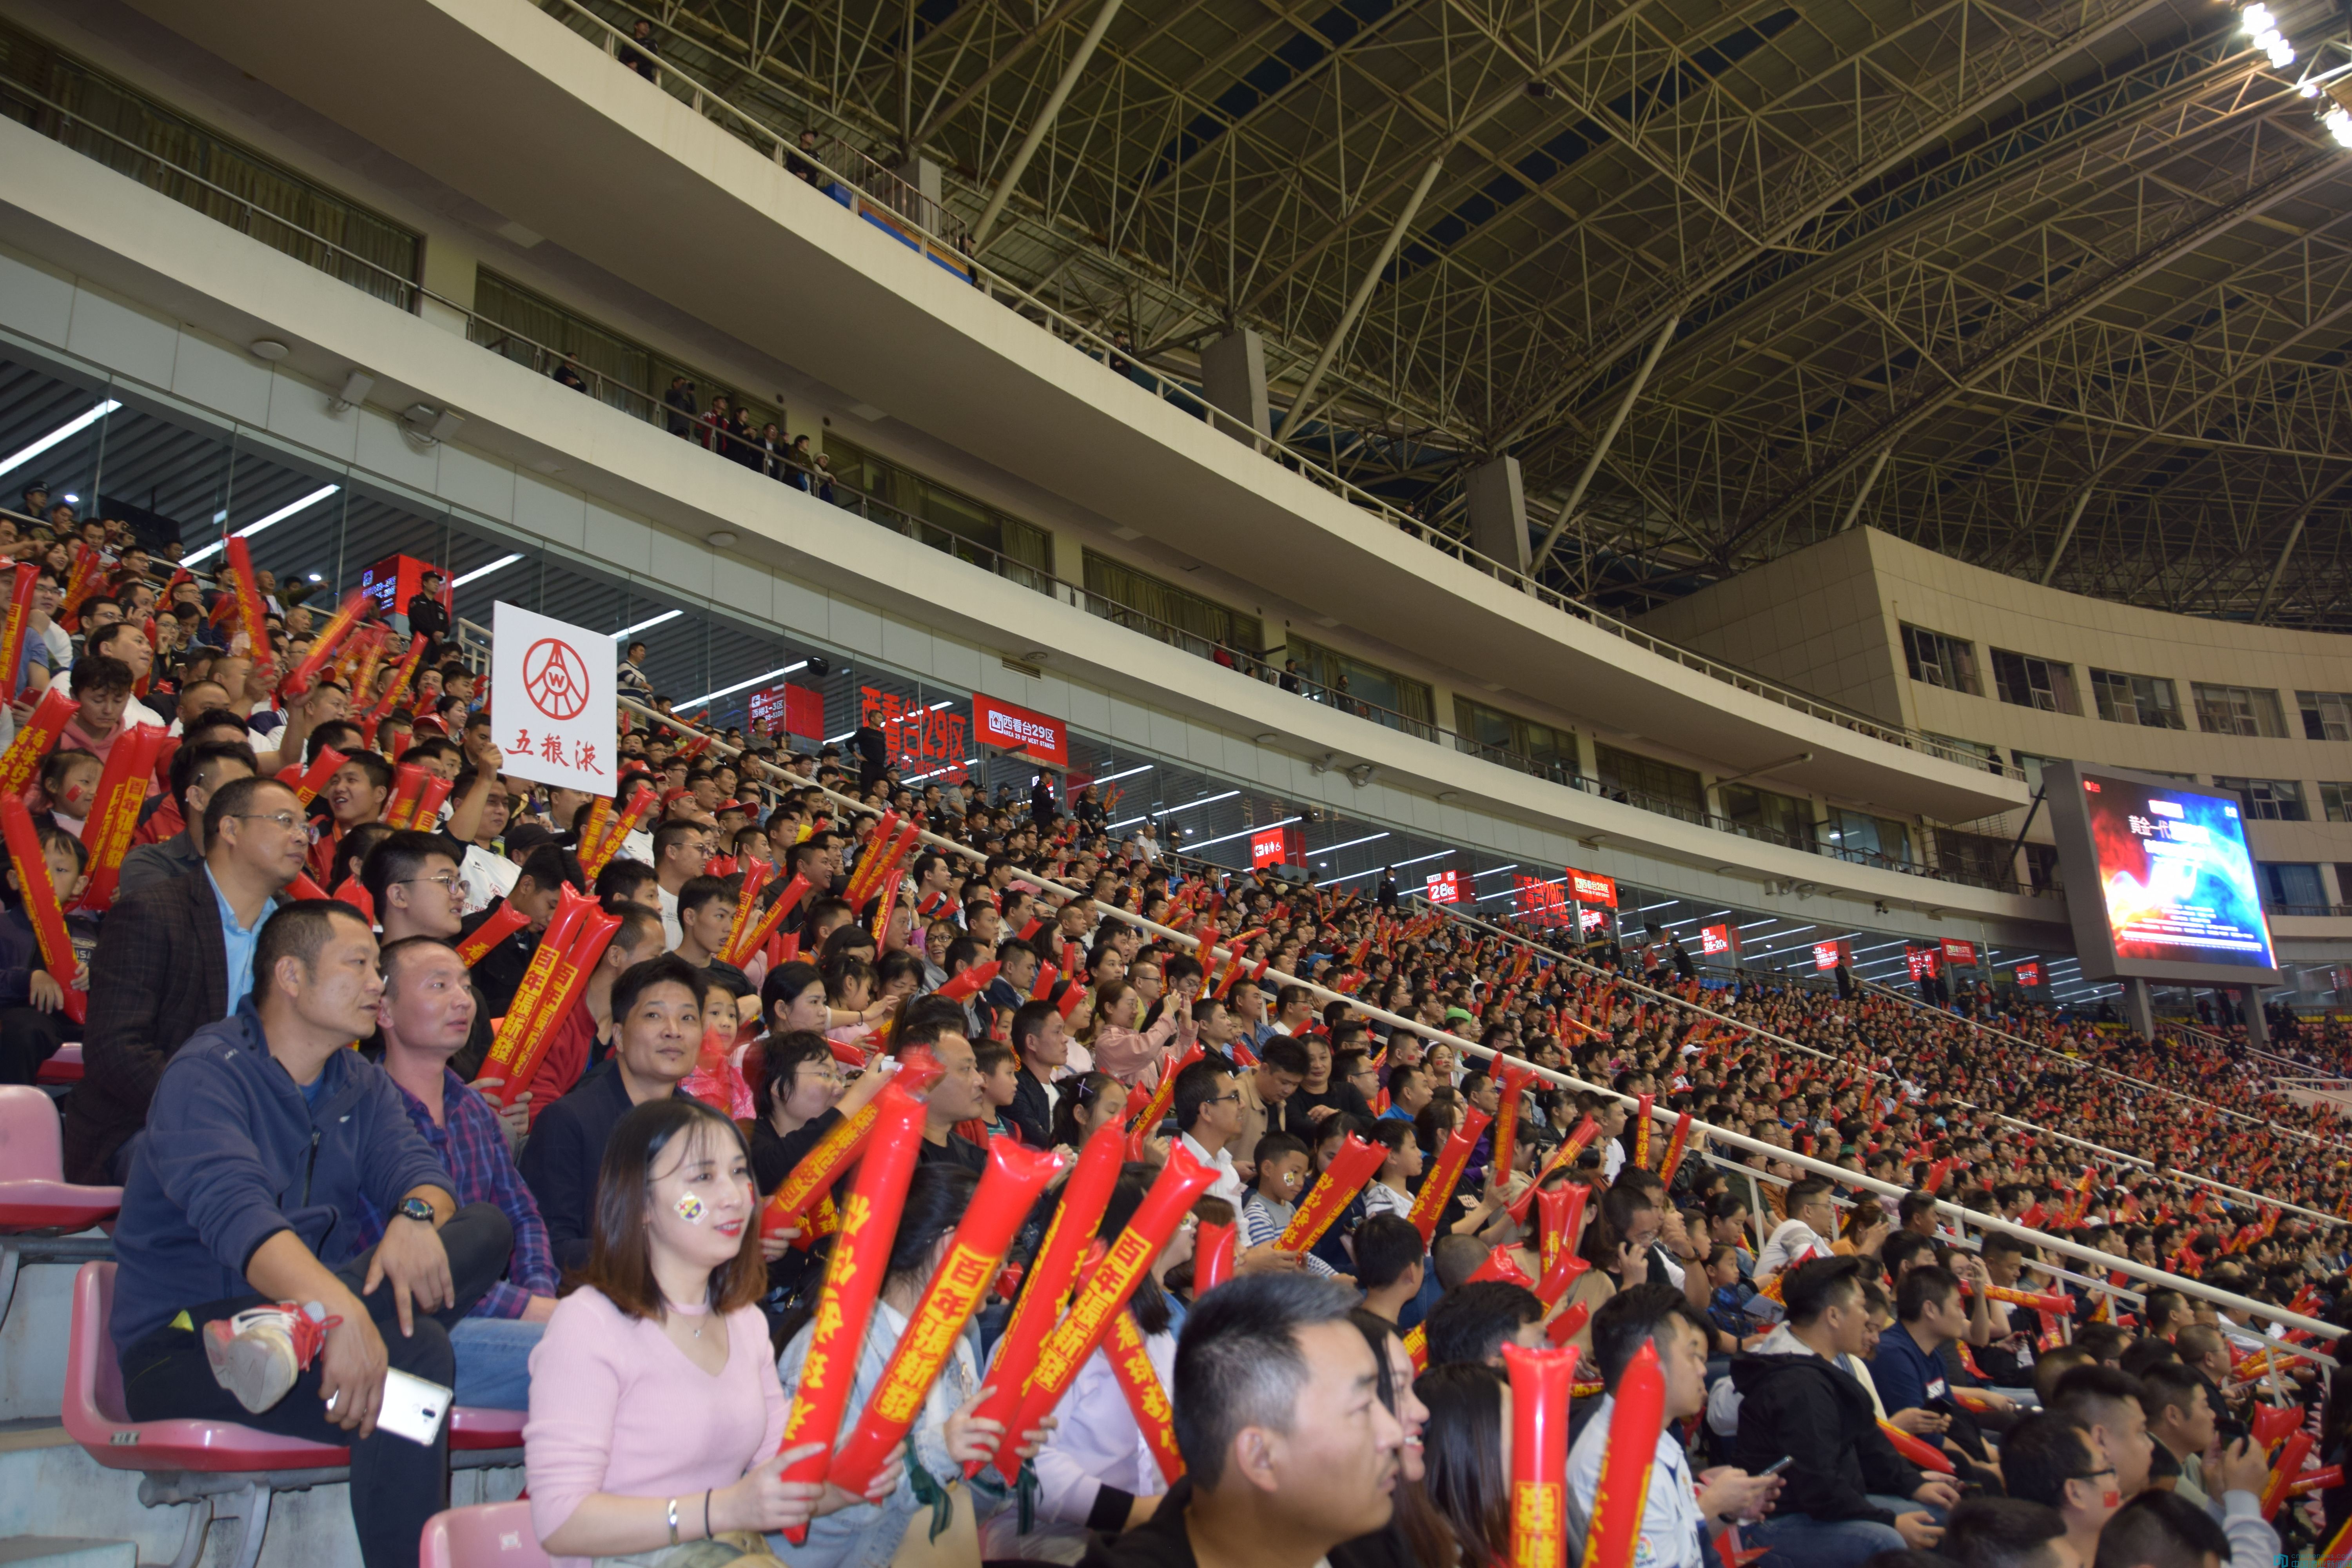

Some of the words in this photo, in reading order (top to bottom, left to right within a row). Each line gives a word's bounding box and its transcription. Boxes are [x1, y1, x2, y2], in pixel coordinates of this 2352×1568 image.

[1002, 714, 1055, 743] 西看台29区
[1028, 737, 1039, 746] WEST
[1040, 741, 1055, 750] STANDS
[505, 729, 605, 775] 五粮液
[1430, 883, 1455, 899] 28区
[488, 944, 560, 1065] 百年張新發
[1033, 1225, 1152, 1394] 百年張新發
